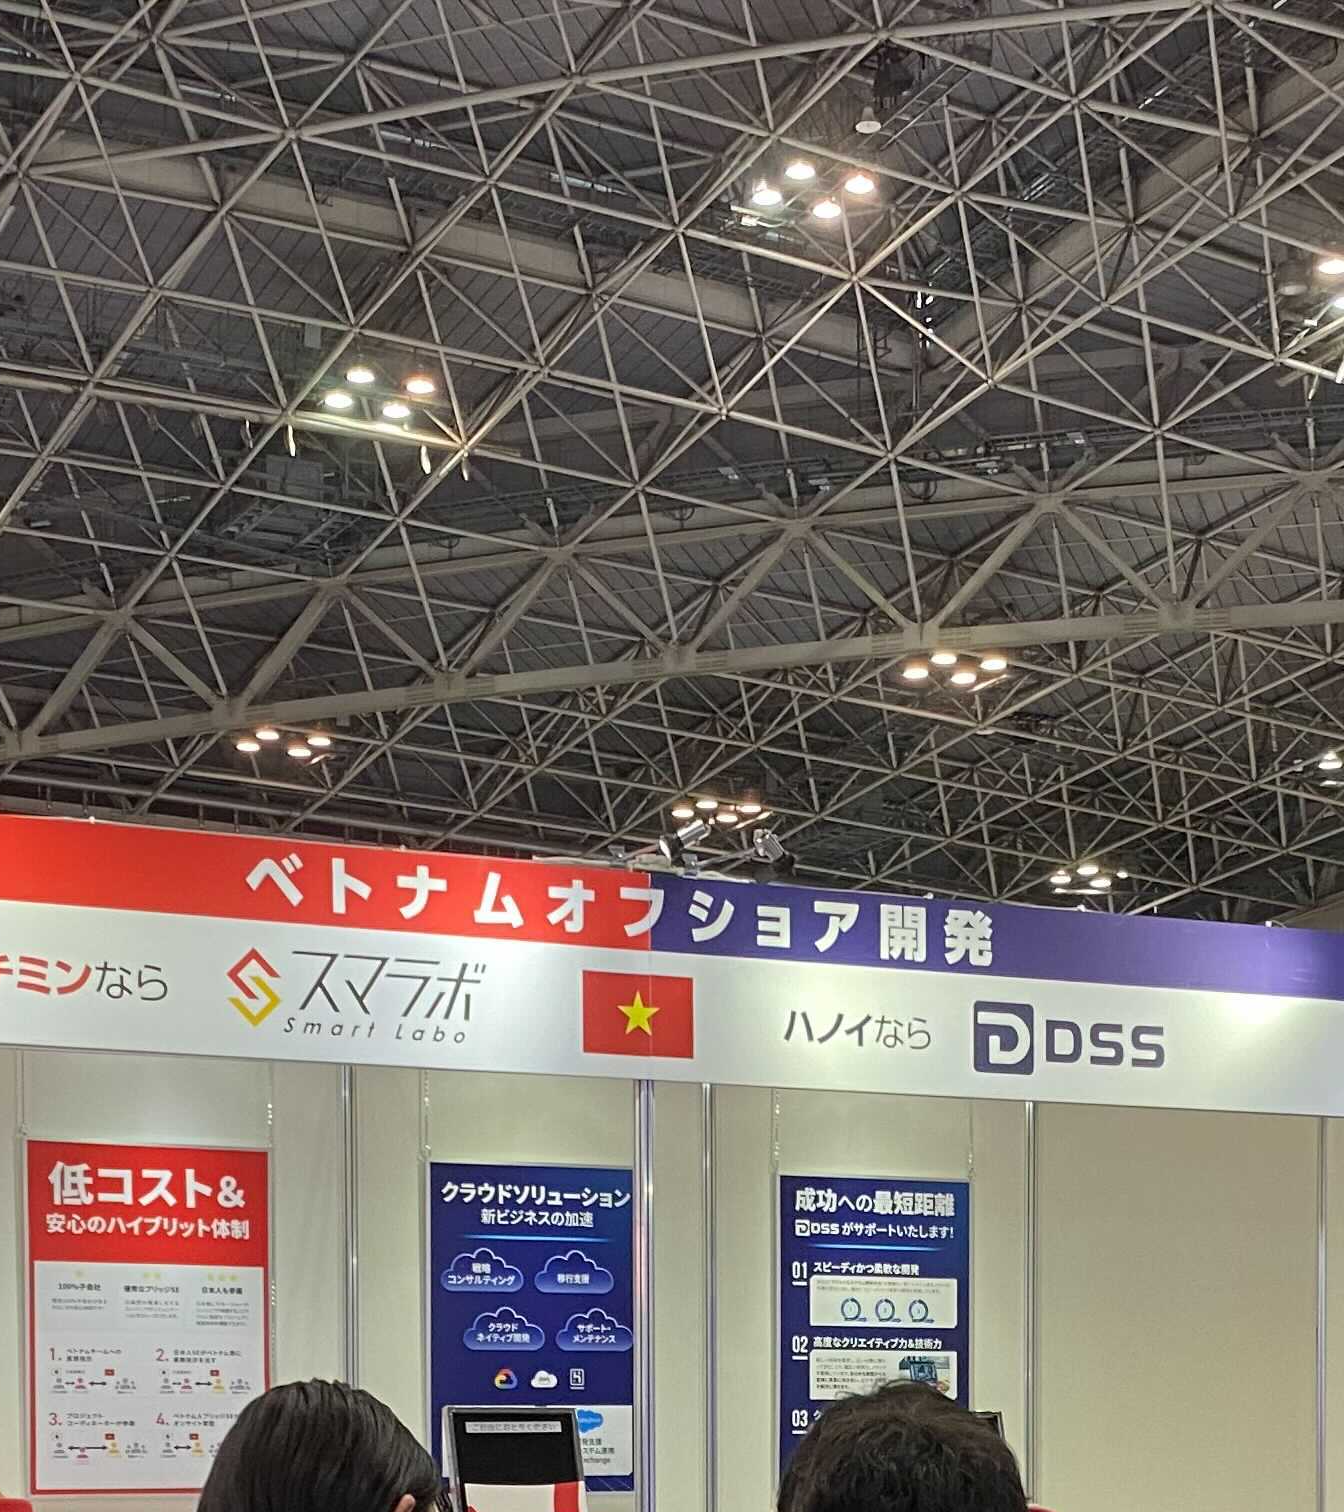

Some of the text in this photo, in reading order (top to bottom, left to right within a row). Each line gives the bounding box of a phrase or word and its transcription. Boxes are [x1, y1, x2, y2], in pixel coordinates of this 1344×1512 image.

[245, 851, 994, 967] ベトナムオフショア開発
[290, 948, 487, 1021] スマラボ
[283, 1016, 467, 1045] Smart Labo
[783, 1010, 931, 1050] ハノイなら
[1044, 1020, 1166, 1070] DSS
[48, 1160, 246, 1209] 低コスト&
[441, 1182, 631, 1209] クラウドソリューション
[795, 1187, 955, 1217] 成功への最短距離
[481, 1209, 594, 1228] 新ビジネスの加速
[447, 1274, 515, 1286] コンサルティング
[792, 1261, 808, 1280] 01
[792, 1335, 808, 1354] 02
[792, 1410, 808, 1428] 03
